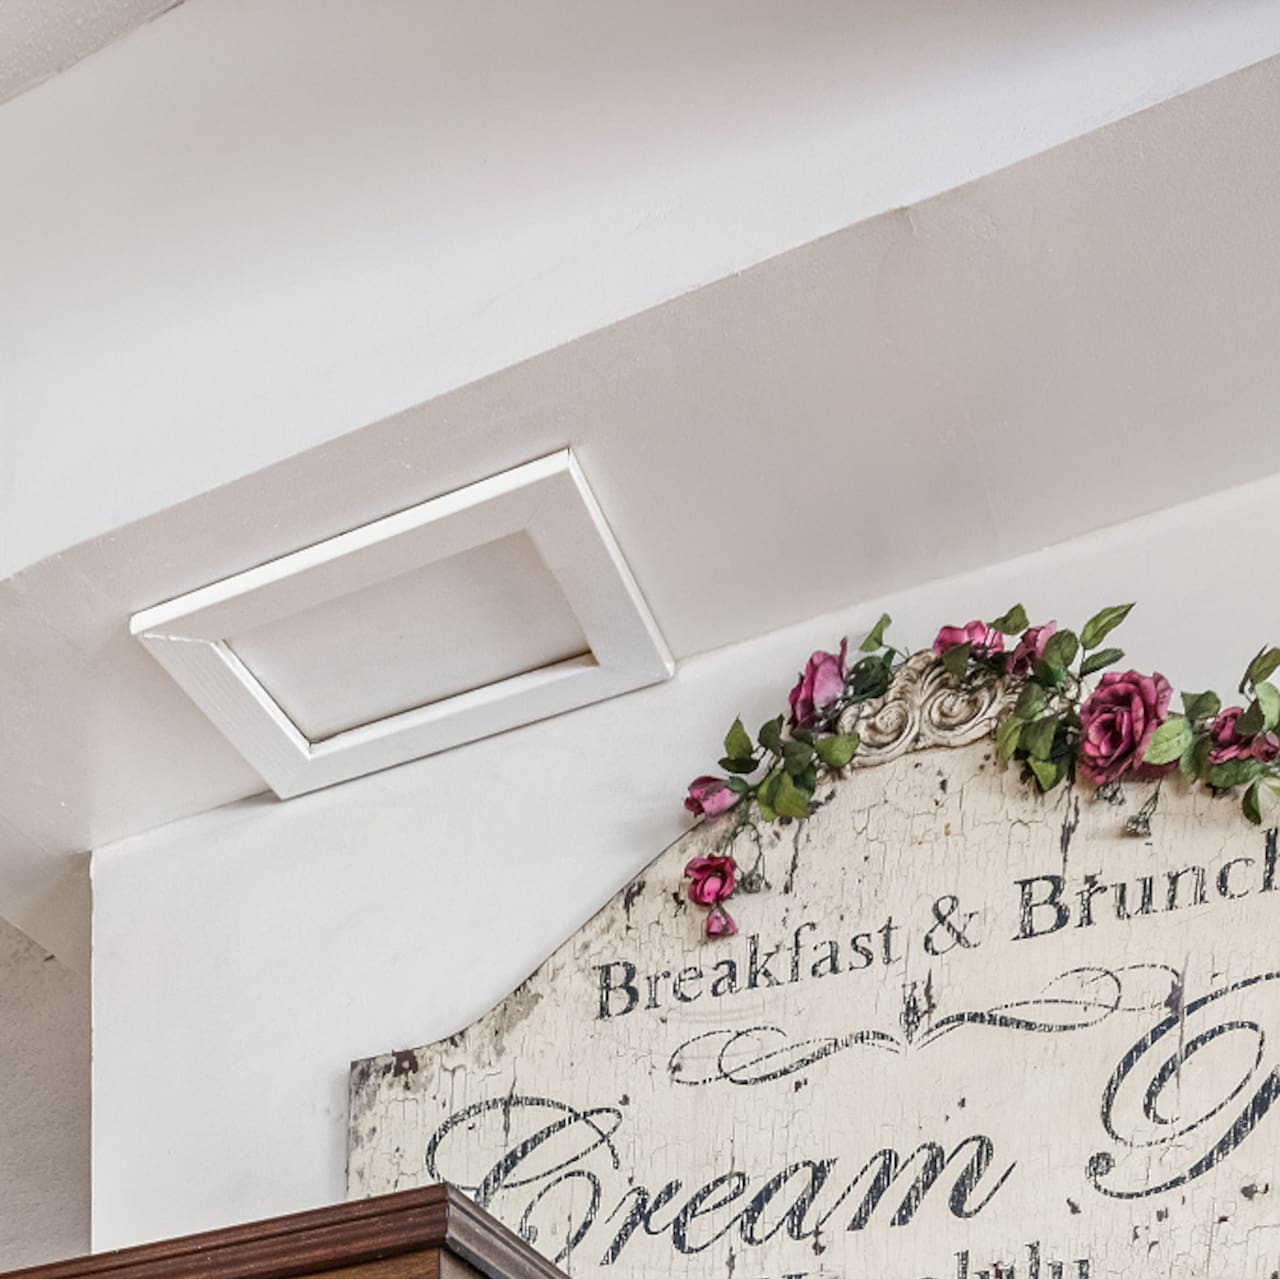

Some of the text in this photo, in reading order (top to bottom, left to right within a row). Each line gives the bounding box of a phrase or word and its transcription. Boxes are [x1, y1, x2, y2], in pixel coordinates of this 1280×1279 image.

[596, 916, 901, 1020] Breakfast
[924, 896, 980, 957] &
[425, 1095, 1017, 1267] Cream
